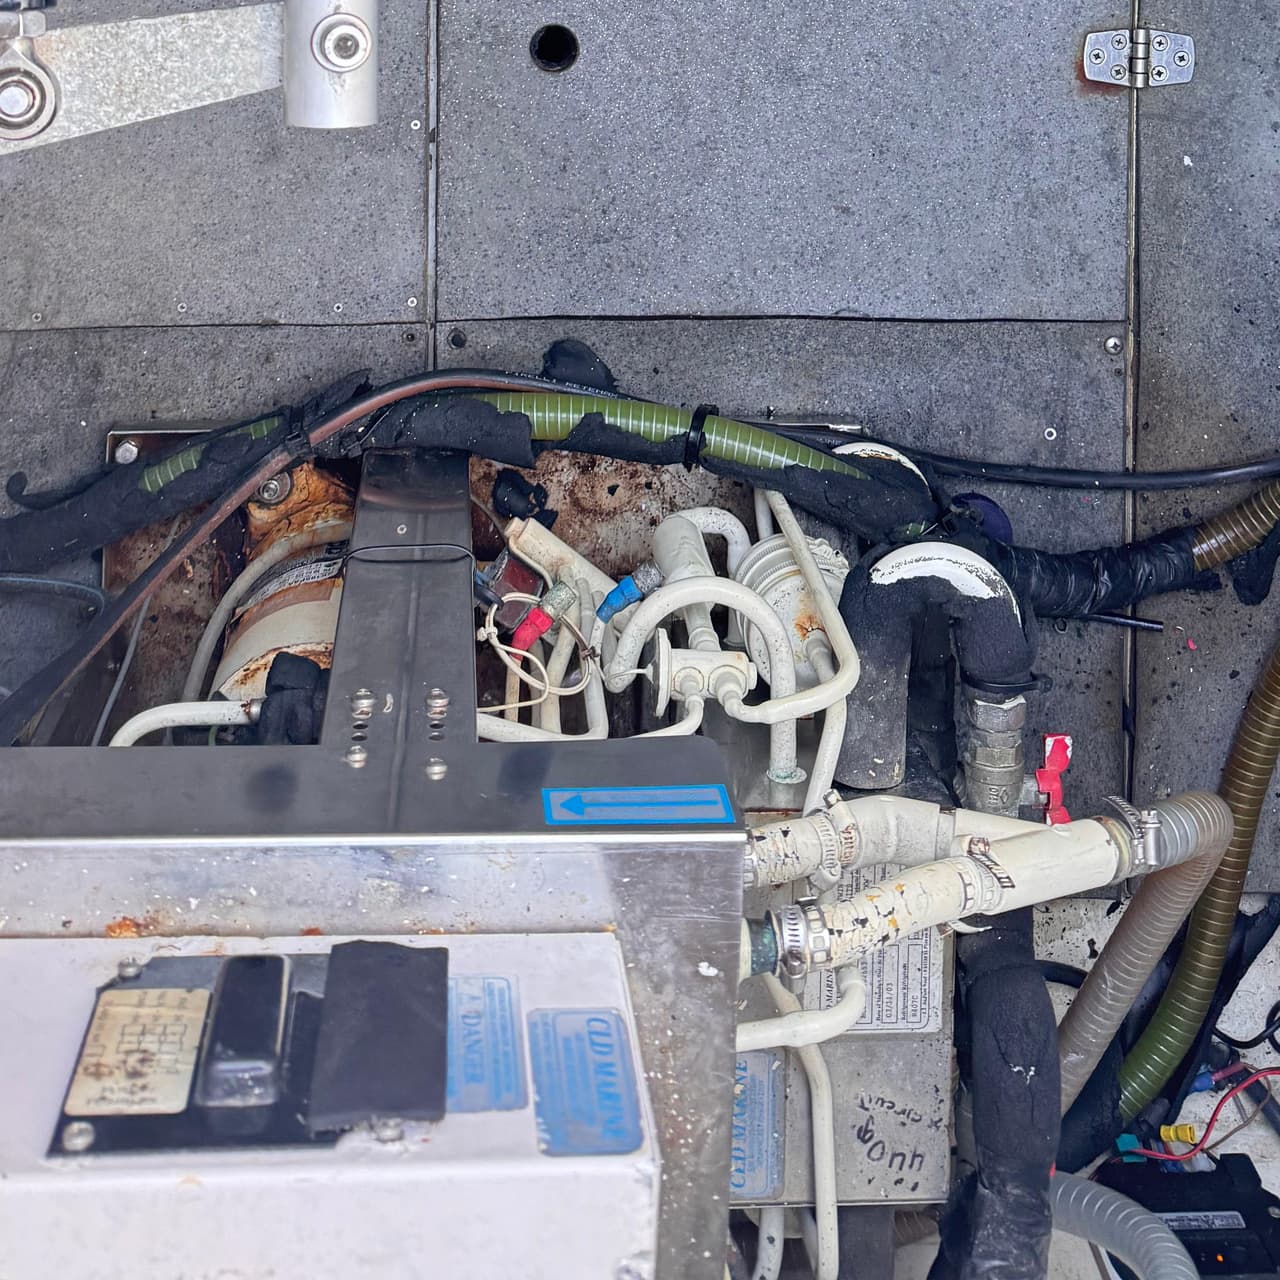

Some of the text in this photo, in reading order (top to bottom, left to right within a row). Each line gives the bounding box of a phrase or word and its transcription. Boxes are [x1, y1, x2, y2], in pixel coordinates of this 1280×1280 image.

[508, 371, 557, 384] IRELLI
[462, 1014, 484, 1083] DANGER
[586, 1017, 627, 1139] CLD MARINE
[731, 1059, 748, 1143] MARNE
